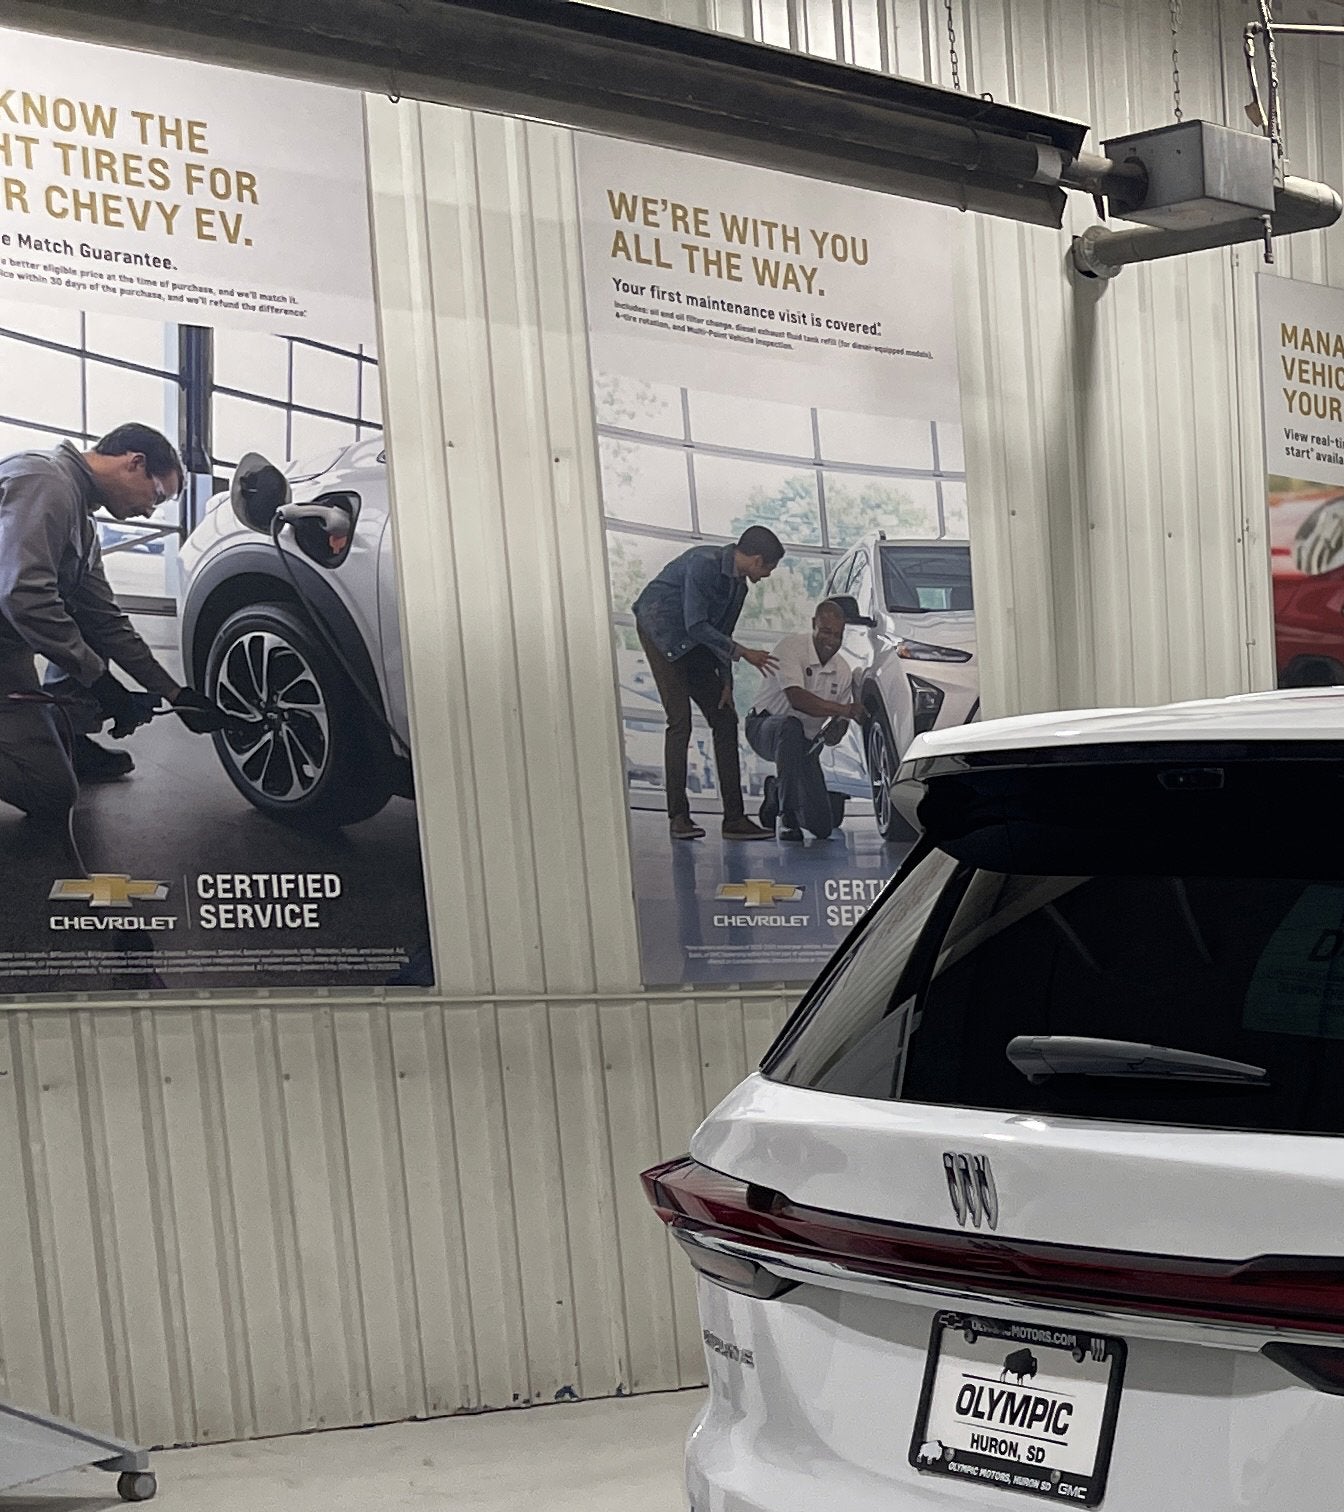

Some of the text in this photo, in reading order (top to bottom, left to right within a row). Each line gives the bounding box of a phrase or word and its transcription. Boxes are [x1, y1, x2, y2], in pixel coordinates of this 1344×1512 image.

[131, 110, 209, 155] THE
[53, 141, 171, 191] TIRES
[185, 162, 259, 205] FOR
[45, 185, 181, 236] CHEVY
[195, 206, 253, 247] EV.
[606, 189, 869, 266] WE'RE WITH YOU
[17, 233, 74, 257] Match
[79, 242, 178, 271] Guarantee.
[610, 229, 826, 297] ALL THE WAY.
[9, 257, 40, 270] better
[43, 263, 78, 276] eligible
[80, 269, 104, 280] price
[106, 273, 116, 281] at
[118, 274, 134, 284] the
[136, 276, 158, 287] time
[159, 279, 170, 288] of
[171, 282, 217, 296] purchase,
[218, 288, 235, 297] and
[259, 293, 288, 303] match
[16, 272, 48, 284] within
[50, 276, 63, 286] 30
[64, 278, 87, 291] days
[89, 282, 100, 291] of
[101, 283, 118, 294] the
[119, 287, 166, 301] purchase,
[167, 294, 185, 303] and
[208, 299, 240, 310] refund
[241, 302, 257, 312] the
[612, 277, 647, 297] Your
[649, 284, 683, 304] first
[685, 293, 776, 321] maintenance
[778, 308, 808, 326] visit
[810, 312, 823, 328] is
[1282, 386, 1343, 423] YOUR
[1283, 427, 1309, 443] View
[196, 872, 343, 900] CERTIFIED
[49, 915, 179, 932] CHEVROLET
[199, 902, 321, 930] SERVICE
[712, 914, 811, 928] CHEVROLET
[955, 1383, 1074, 1436] OLYMPIC
[970, 1432, 1046, 1464] HURON, SD
[948, 1461, 1052, 1492] OLYMPIC MOTORS, HURON SD
[1057, 1482, 1088, 1500] GMC
